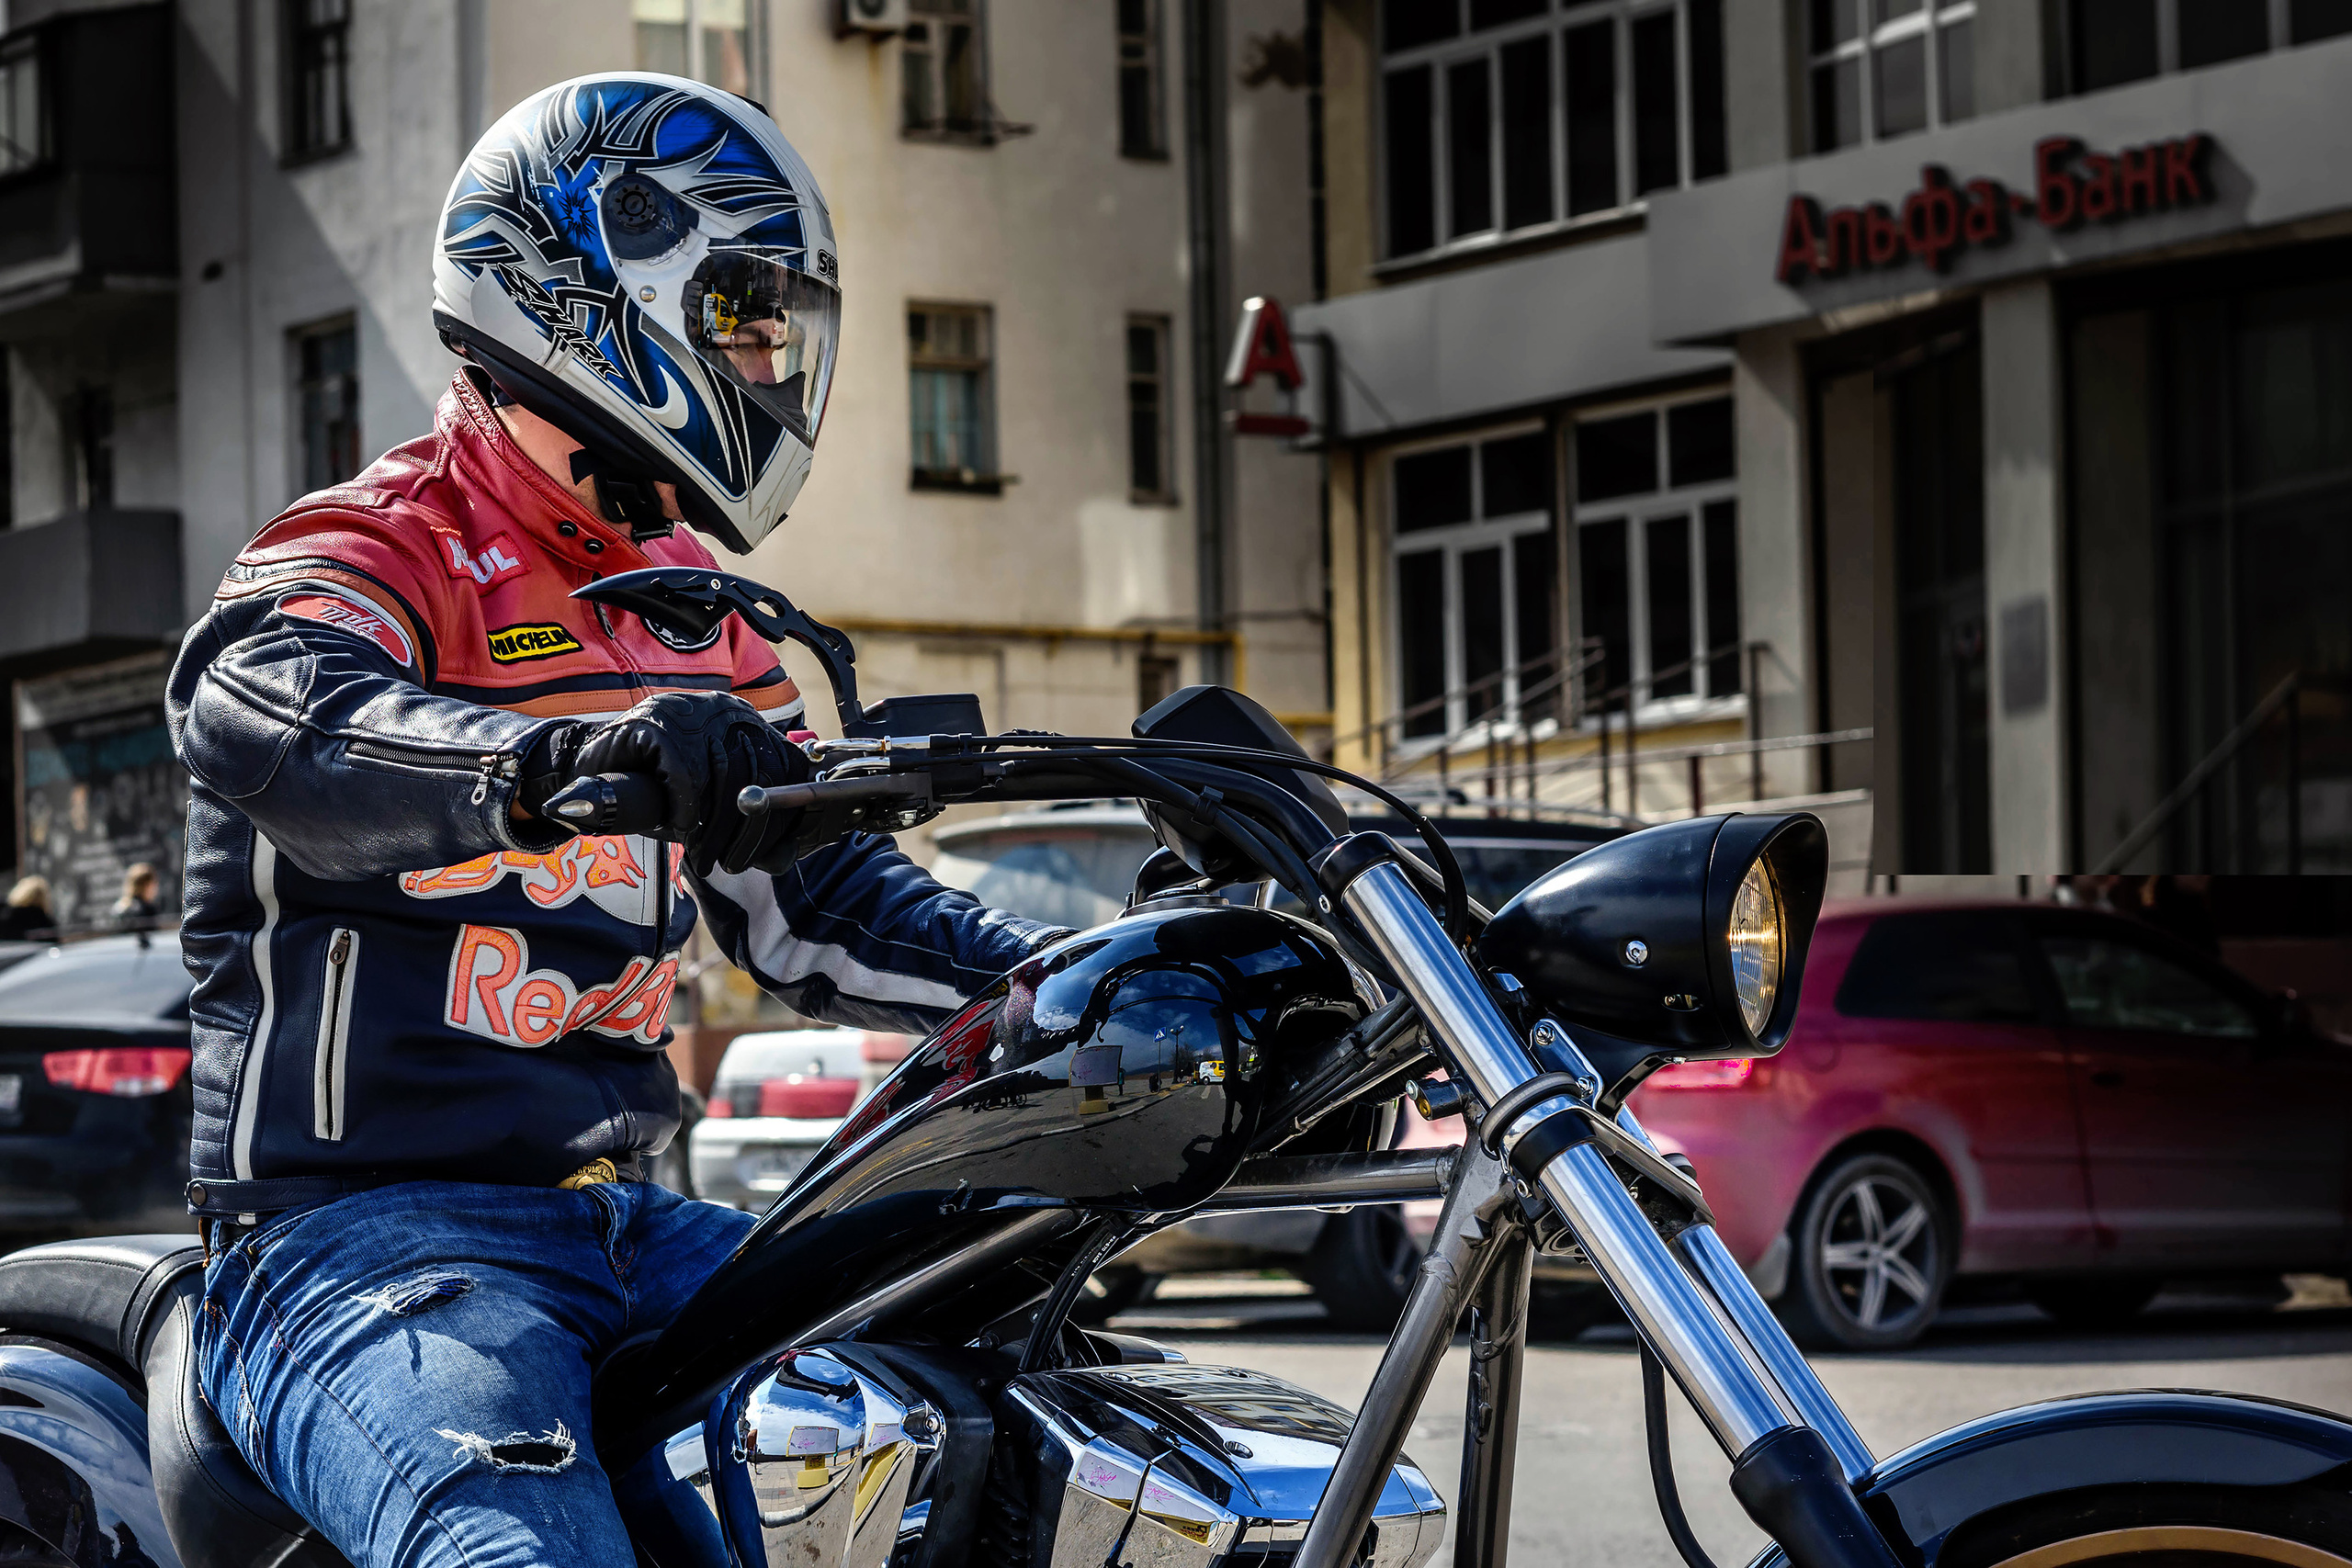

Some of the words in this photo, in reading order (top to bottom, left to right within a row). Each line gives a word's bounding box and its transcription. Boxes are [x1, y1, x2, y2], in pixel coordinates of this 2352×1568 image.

[1776, 133, 2207, 280] Альфа-Банк
[497, 261, 628, 381] SHARK
[491, 629, 573, 656] MICHELIN
